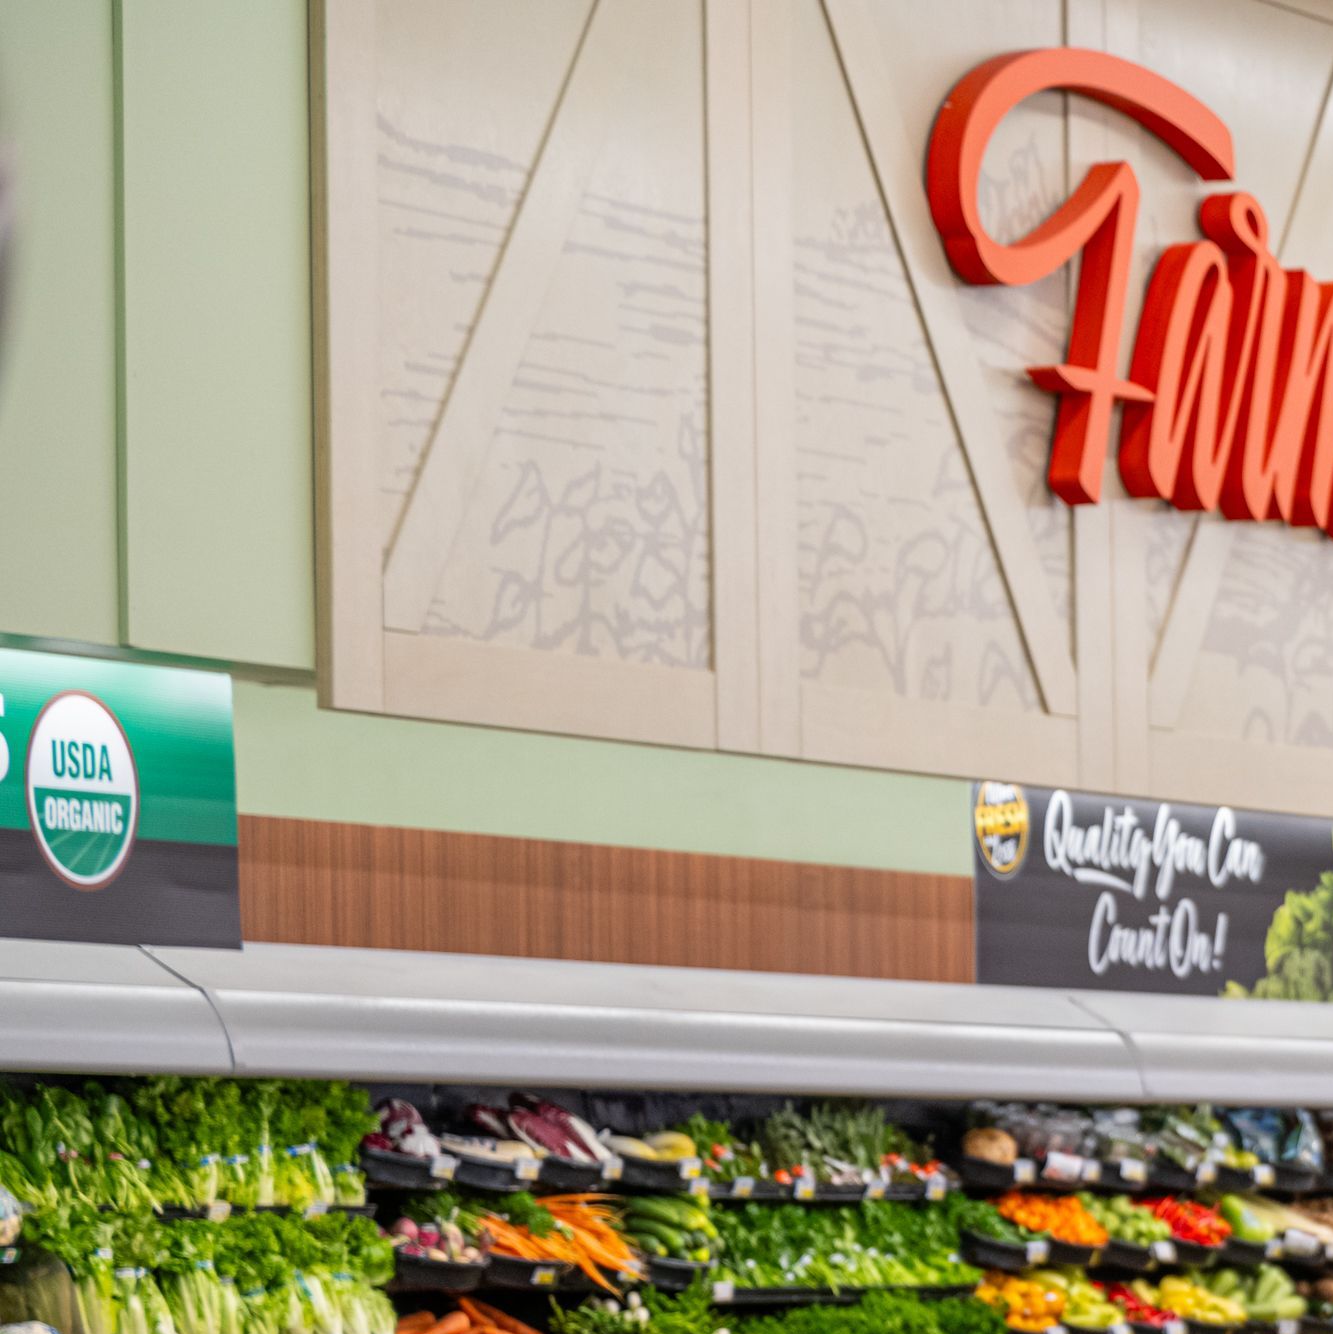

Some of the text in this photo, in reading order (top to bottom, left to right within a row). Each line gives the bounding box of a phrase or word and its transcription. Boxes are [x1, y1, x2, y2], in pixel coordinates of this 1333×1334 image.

[51, 737, 113, 783] USDA
[44, 795, 124, 836] ORGANIC
[1044, 789, 1154, 901] Quality
[1152, 803, 1209, 902] You
[1208, 806, 1267, 889] Can
[1088, 890, 1229, 979] Count On!
